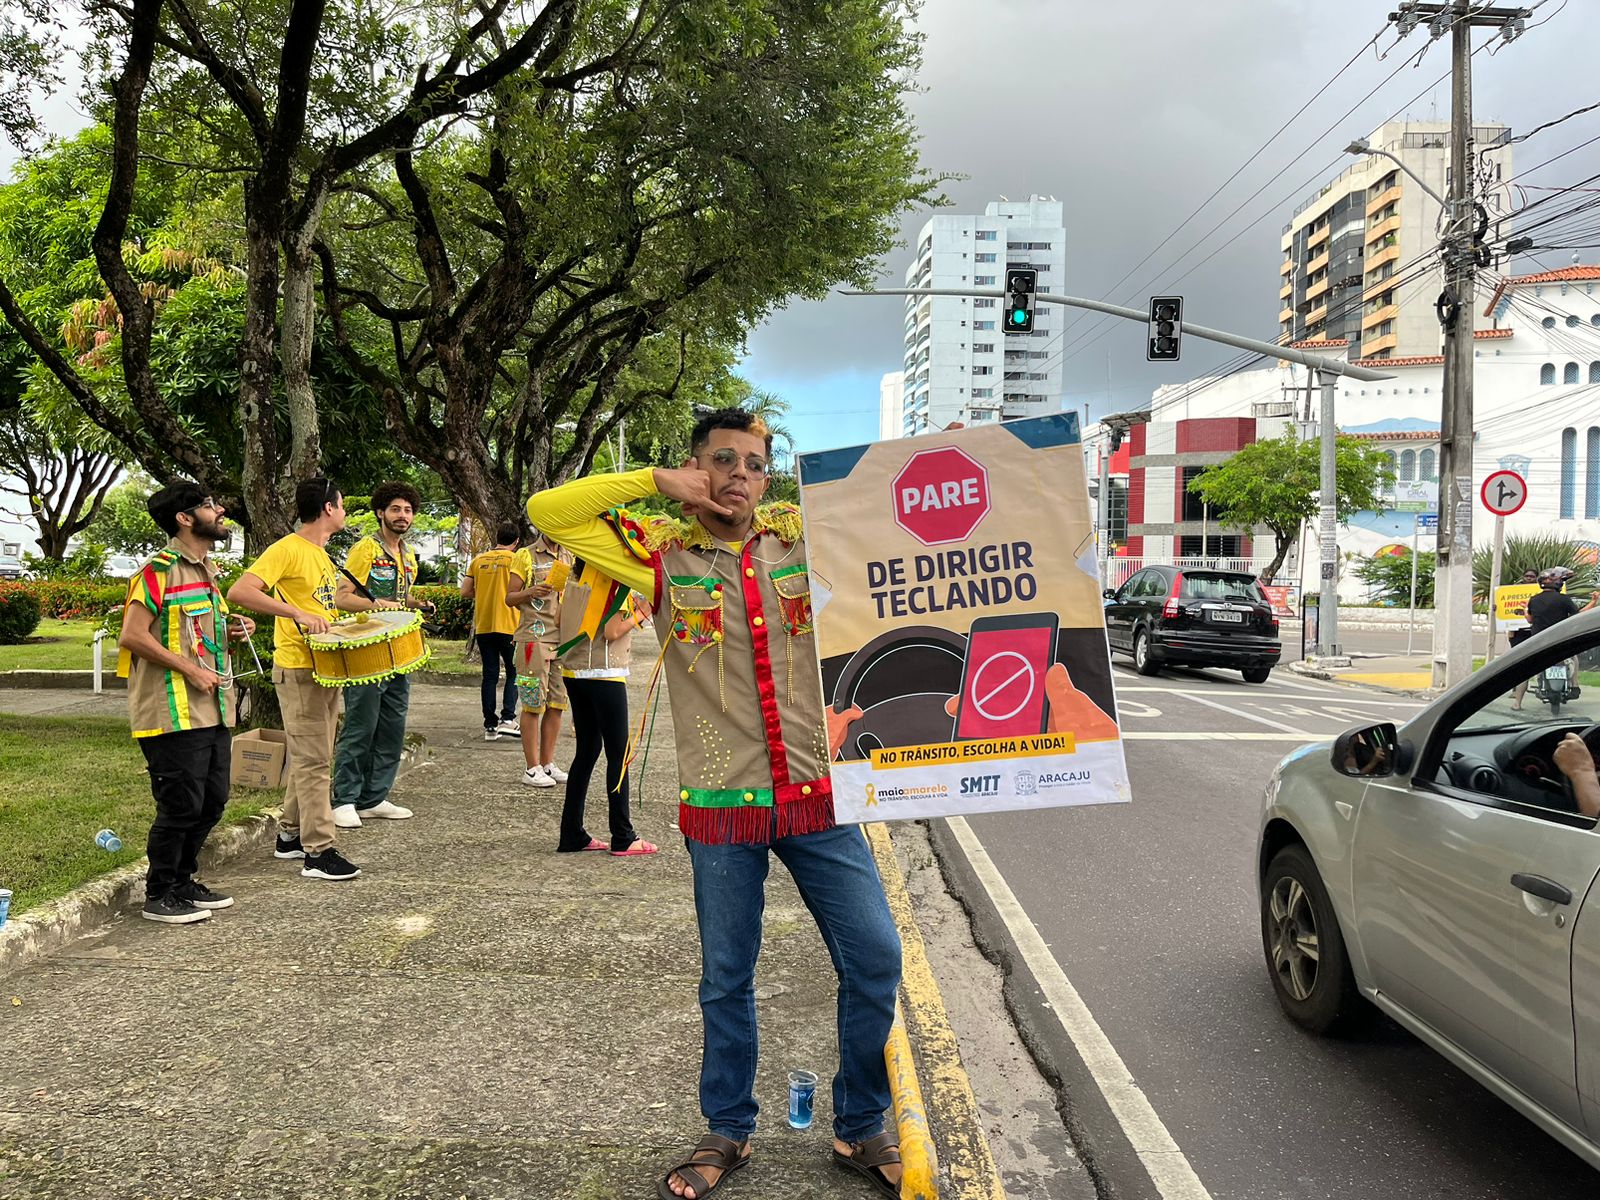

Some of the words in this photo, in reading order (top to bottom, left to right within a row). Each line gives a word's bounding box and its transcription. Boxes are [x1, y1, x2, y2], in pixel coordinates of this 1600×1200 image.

[902, 477, 980, 514] PARE
[867, 558, 906, 588] DE
[914, 541, 1034, 582] DIRIGIR
[871, 573, 1037, 619] TECLANDO
[880, 752, 897, 764] NO
[901, 746, 960, 762] TRÂNSITO,
[963, 742, 1016, 756] ESCOLHA
[1020, 741, 1028, 751] A
[1031, 737, 1065, 750] VIDA!
[960, 775, 1000, 793] SMTT
[1038, 771, 1090, 783] ARACAJU
